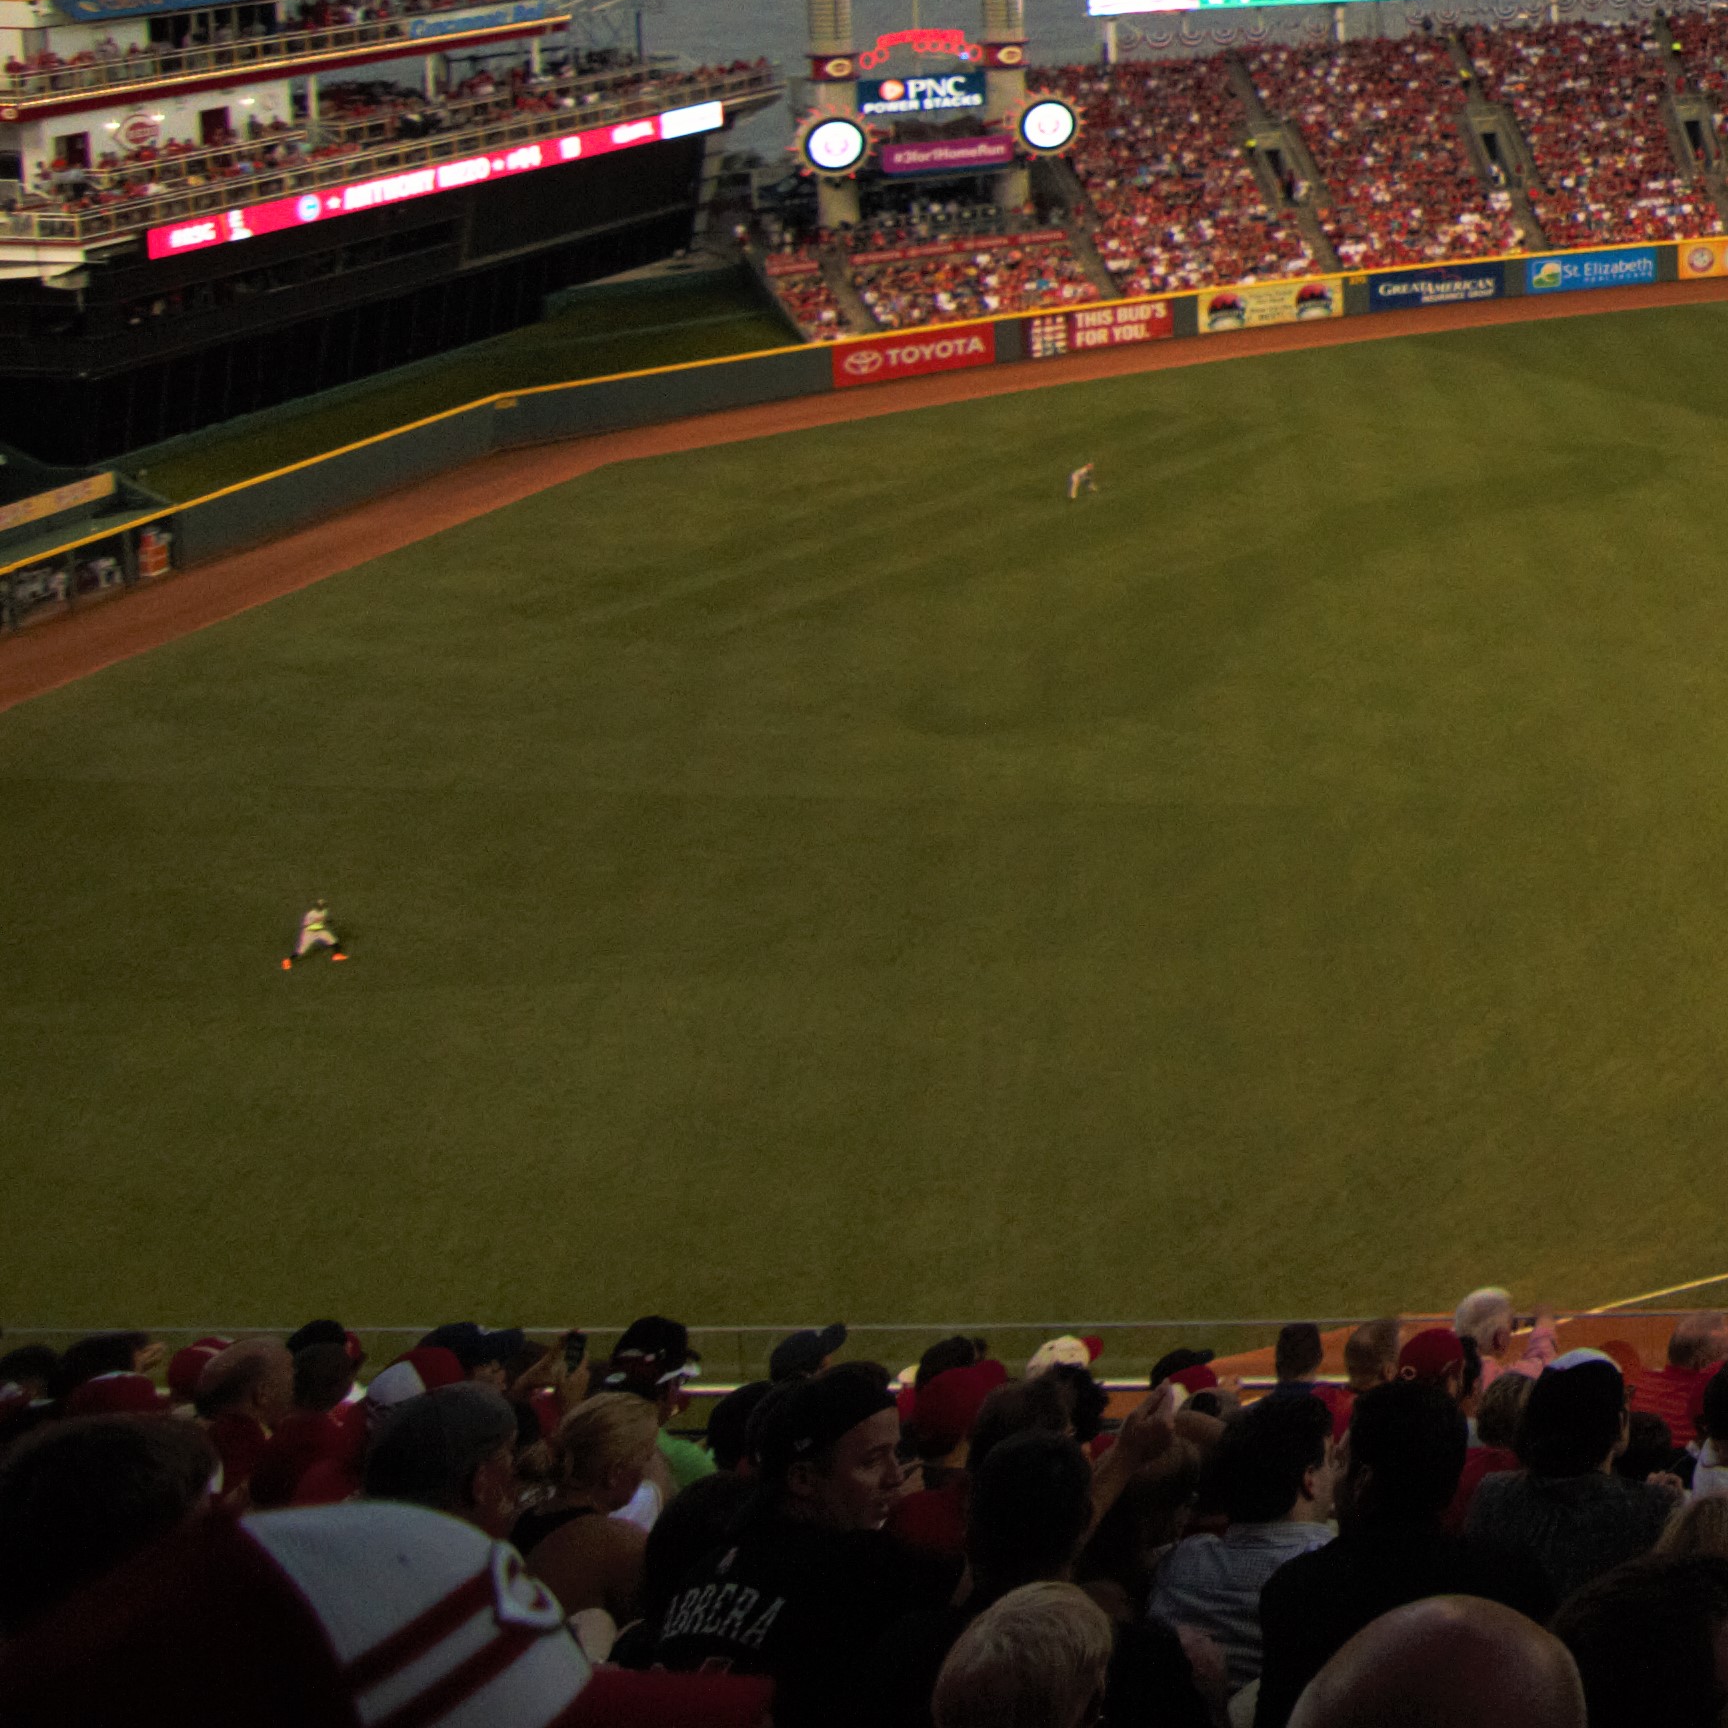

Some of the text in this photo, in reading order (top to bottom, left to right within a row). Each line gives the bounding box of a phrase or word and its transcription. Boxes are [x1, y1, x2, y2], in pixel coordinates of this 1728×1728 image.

[907, 75, 967, 100] PNC
[862, 93, 983, 114] POWER STACKS
[1583, 257, 1653, 276] Elizabeth
[1074, 301, 1168, 329] THIS BUD'S
[1074, 323, 1150, 348] FOR YOU.
[884, 335, 986, 366] TOYOTA
